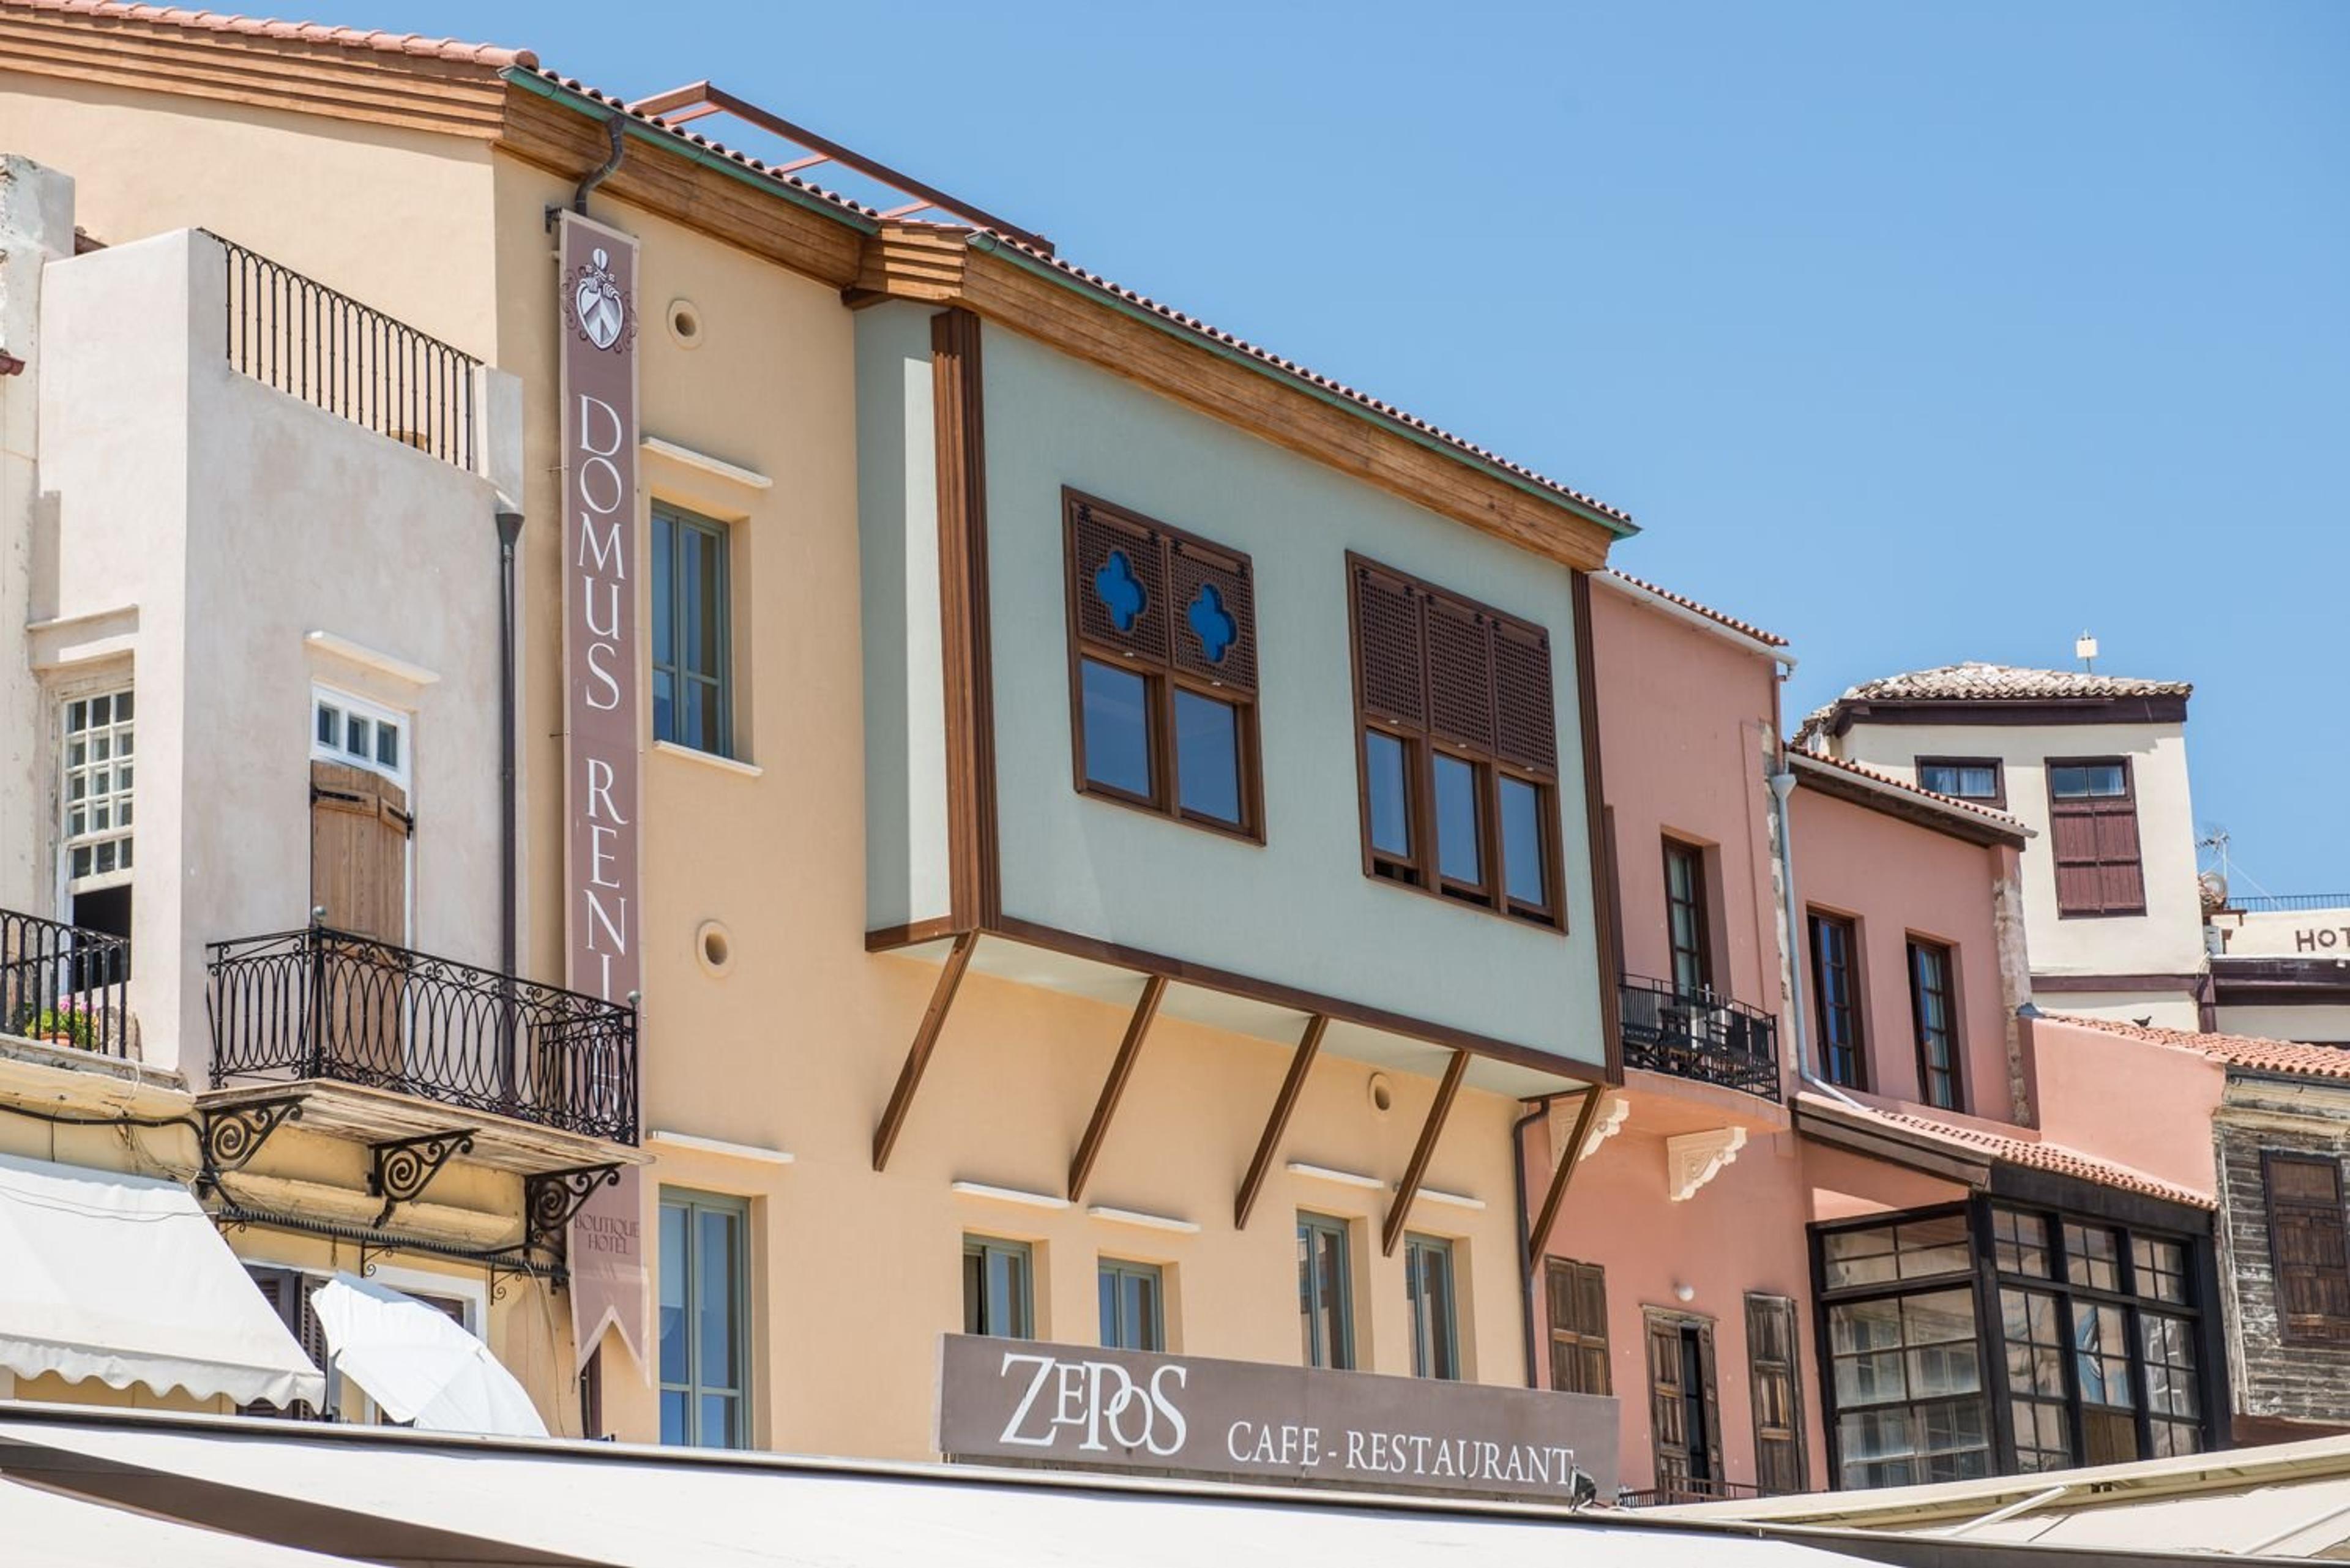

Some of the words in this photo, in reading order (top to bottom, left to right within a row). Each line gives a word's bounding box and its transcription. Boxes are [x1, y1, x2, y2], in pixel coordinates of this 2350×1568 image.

[578, 394, 626, 711] DOMUS
[573, 1213, 640, 1238] BOUTIQUE
[588, 1233, 629, 1254] HOTEL
[999, 1353, 1187, 1456] ZEPOS
[1228, 1421, 1320, 1466] CAFE
[1346, 1430, 1573, 1485] RESTAURANT
